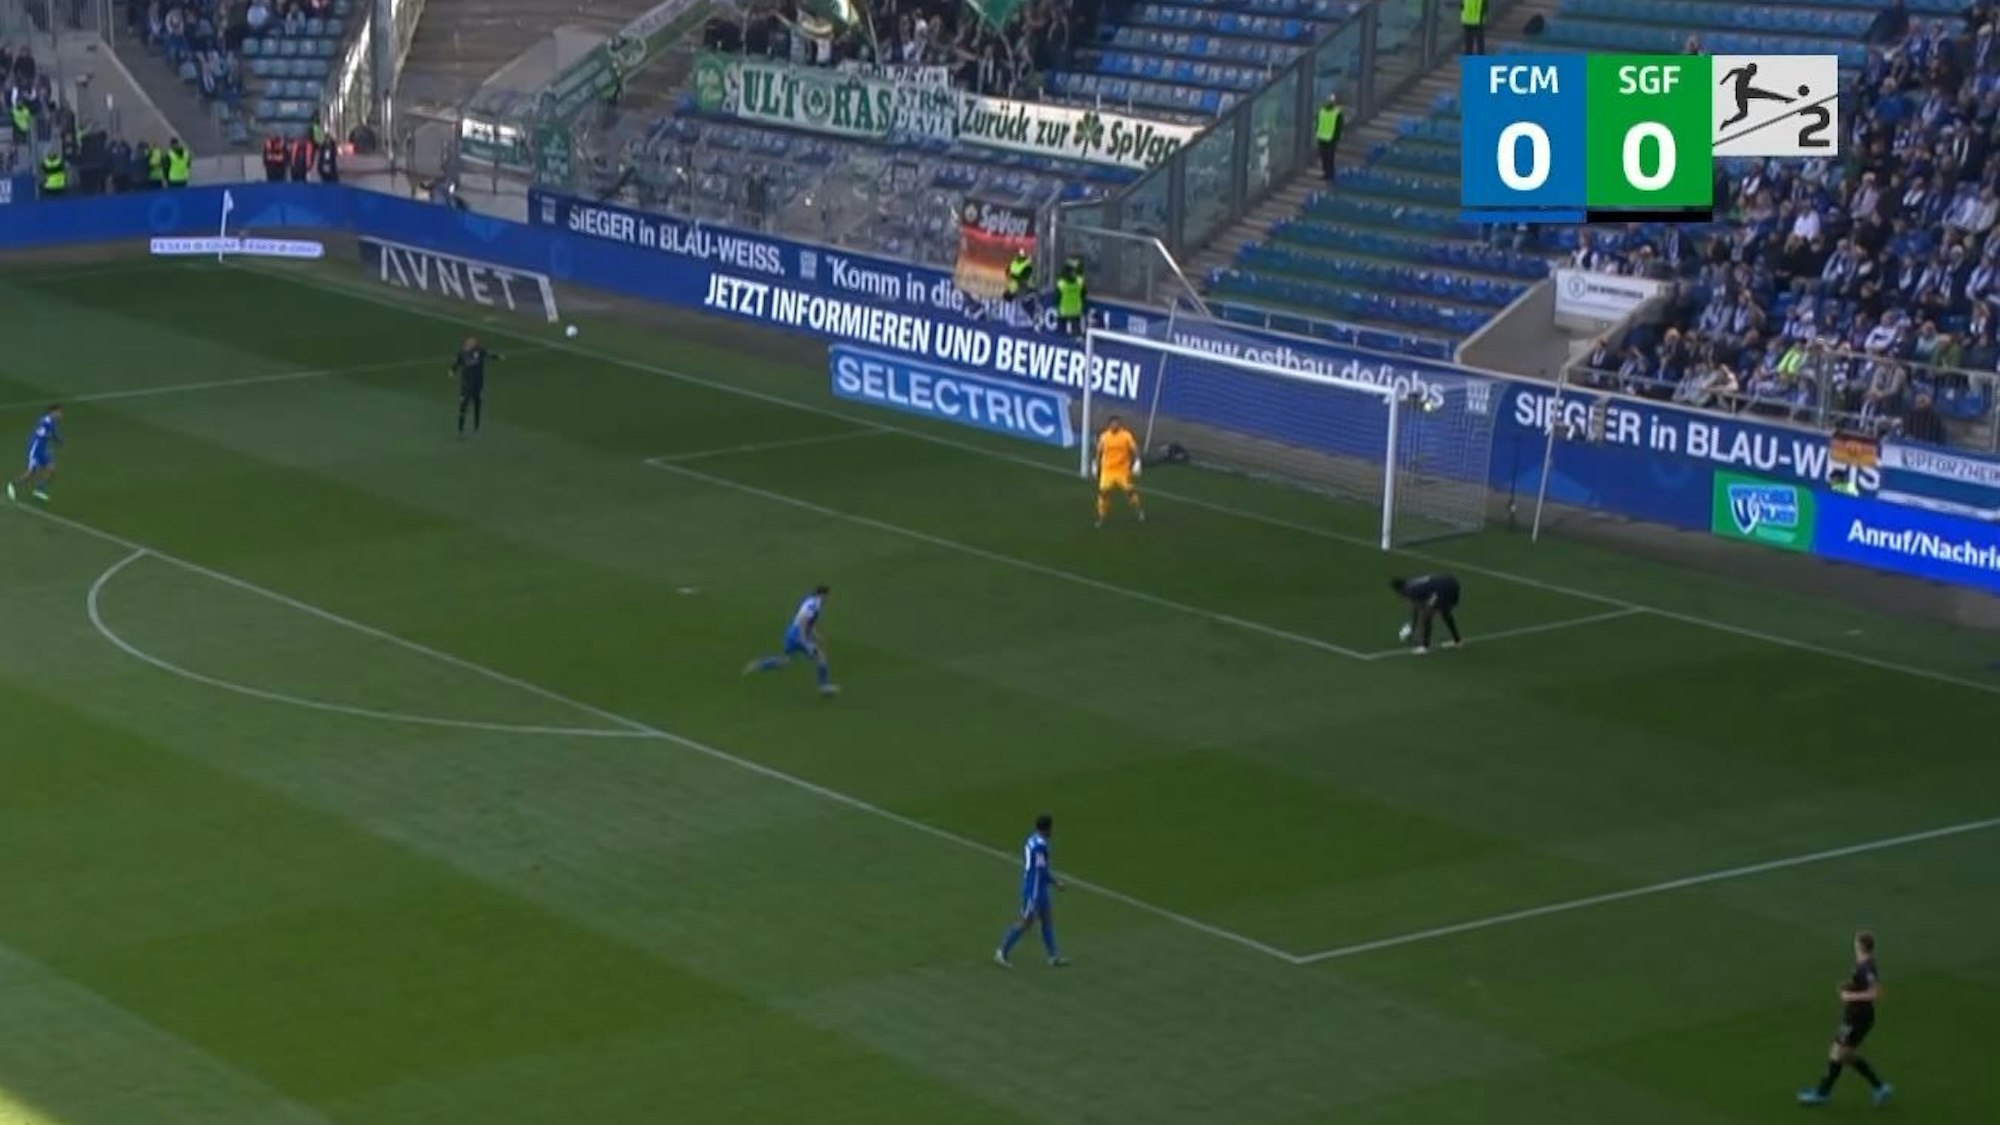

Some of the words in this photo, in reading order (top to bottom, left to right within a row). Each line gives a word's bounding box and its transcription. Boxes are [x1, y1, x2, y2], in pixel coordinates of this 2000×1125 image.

[961, 100, 1031, 142] Zurück
[1035, 118, 1070, 149] zur
[569, 204, 635, 242] SIEGER
[639, 219, 655, 247] in
[905, 271, 925, 303] in
[704, 273, 760, 317] JETZT
[771, 286, 931, 354] INFORMIEREN
[934, 321, 992, 367] UND
[994, 335, 1142, 400] BEWERBEN
[837, 355, 1055, 438] SELECTRIC
[1649, 414, 1677, 452] in
